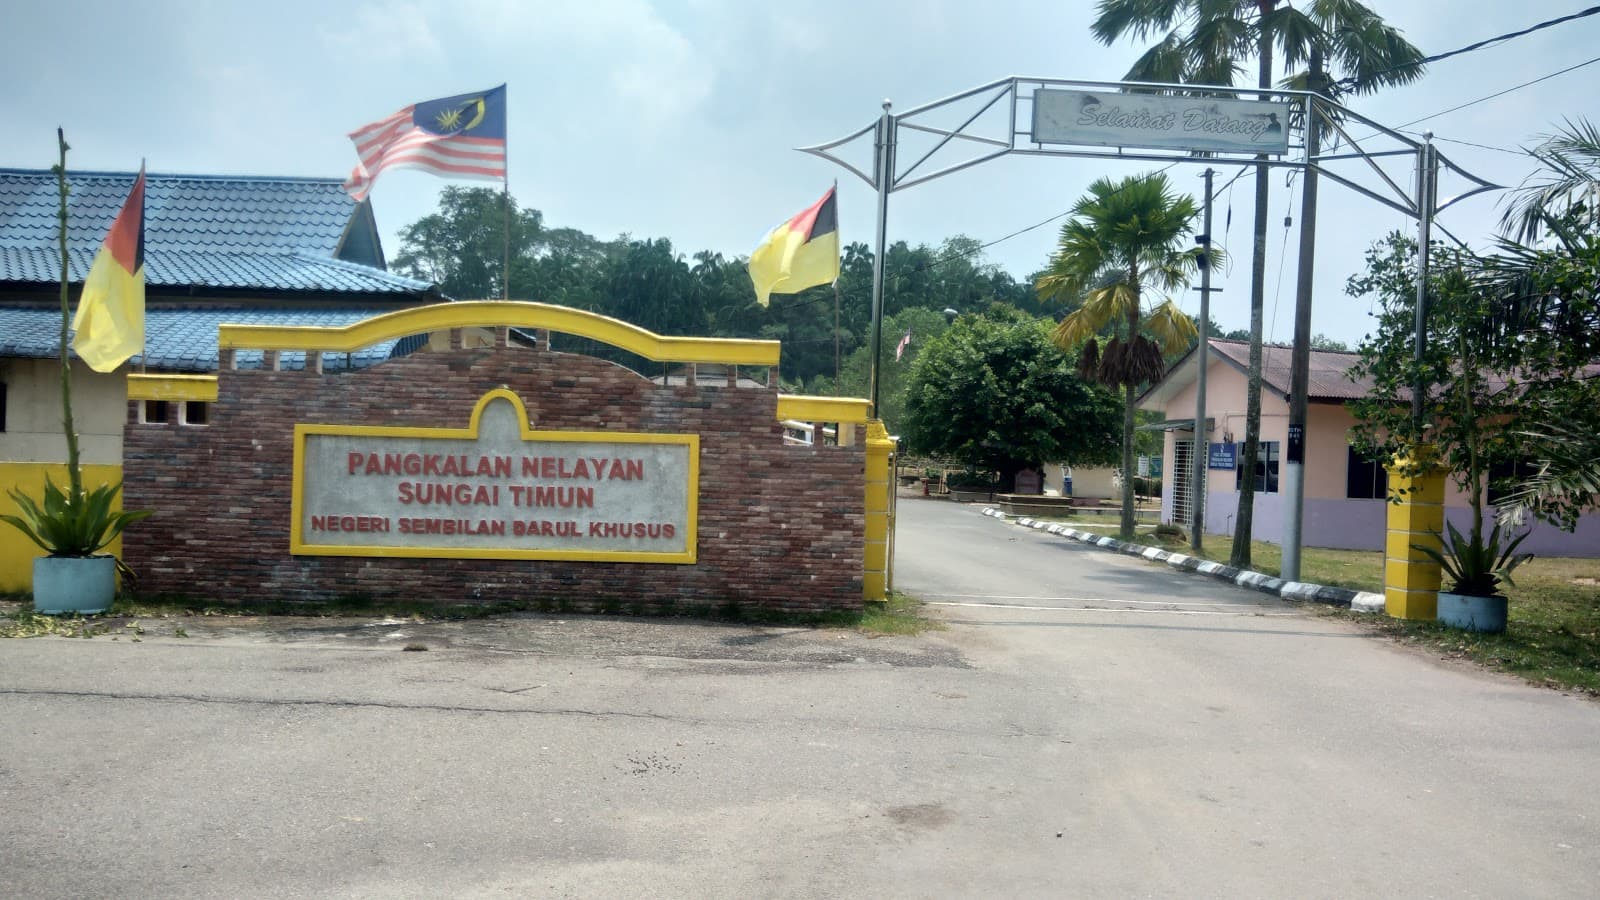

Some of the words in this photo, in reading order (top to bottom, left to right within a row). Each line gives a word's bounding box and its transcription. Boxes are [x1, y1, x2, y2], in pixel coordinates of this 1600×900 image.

[1077, 103, 1176, 130] Selamat
[1183, 108, 1268, 141] Datang
[348, 452, 512, 478] PANGKALAN
[521, 456, 645, 481] NELAYAN
[398, 481, 499, 506] SUNGAI
[508, 485, 595, 508] TIMUN
[311, 515, 390, 533] NEGERI
[398, 517, 505, 537] SEMBILAN
[589, 522, 676, 539] KHUSUS
